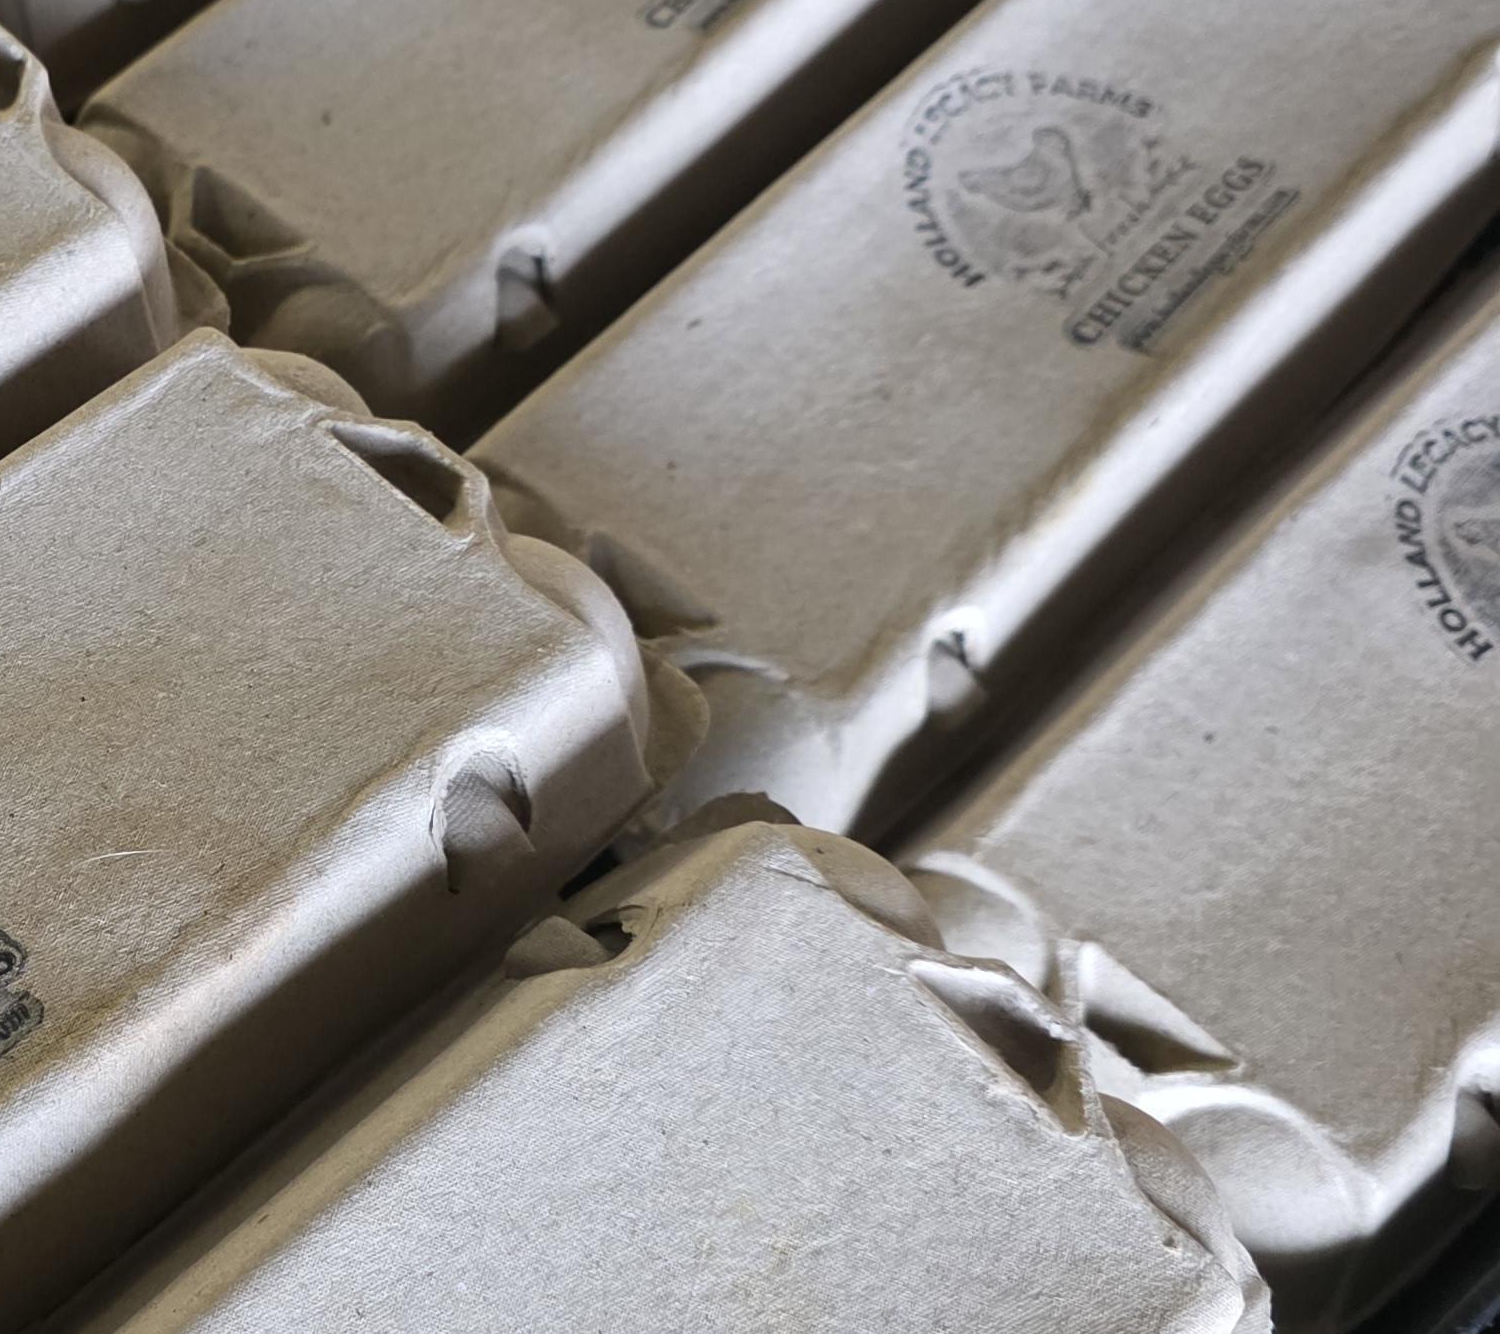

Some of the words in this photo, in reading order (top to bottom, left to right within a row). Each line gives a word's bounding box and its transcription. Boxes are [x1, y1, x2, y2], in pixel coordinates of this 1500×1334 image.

[1071, 220, 1199, 347] CHICKEN
[1186, 155, 1266, 226] EGGS
[1395, 498, 1494, 661] HOLLAND
